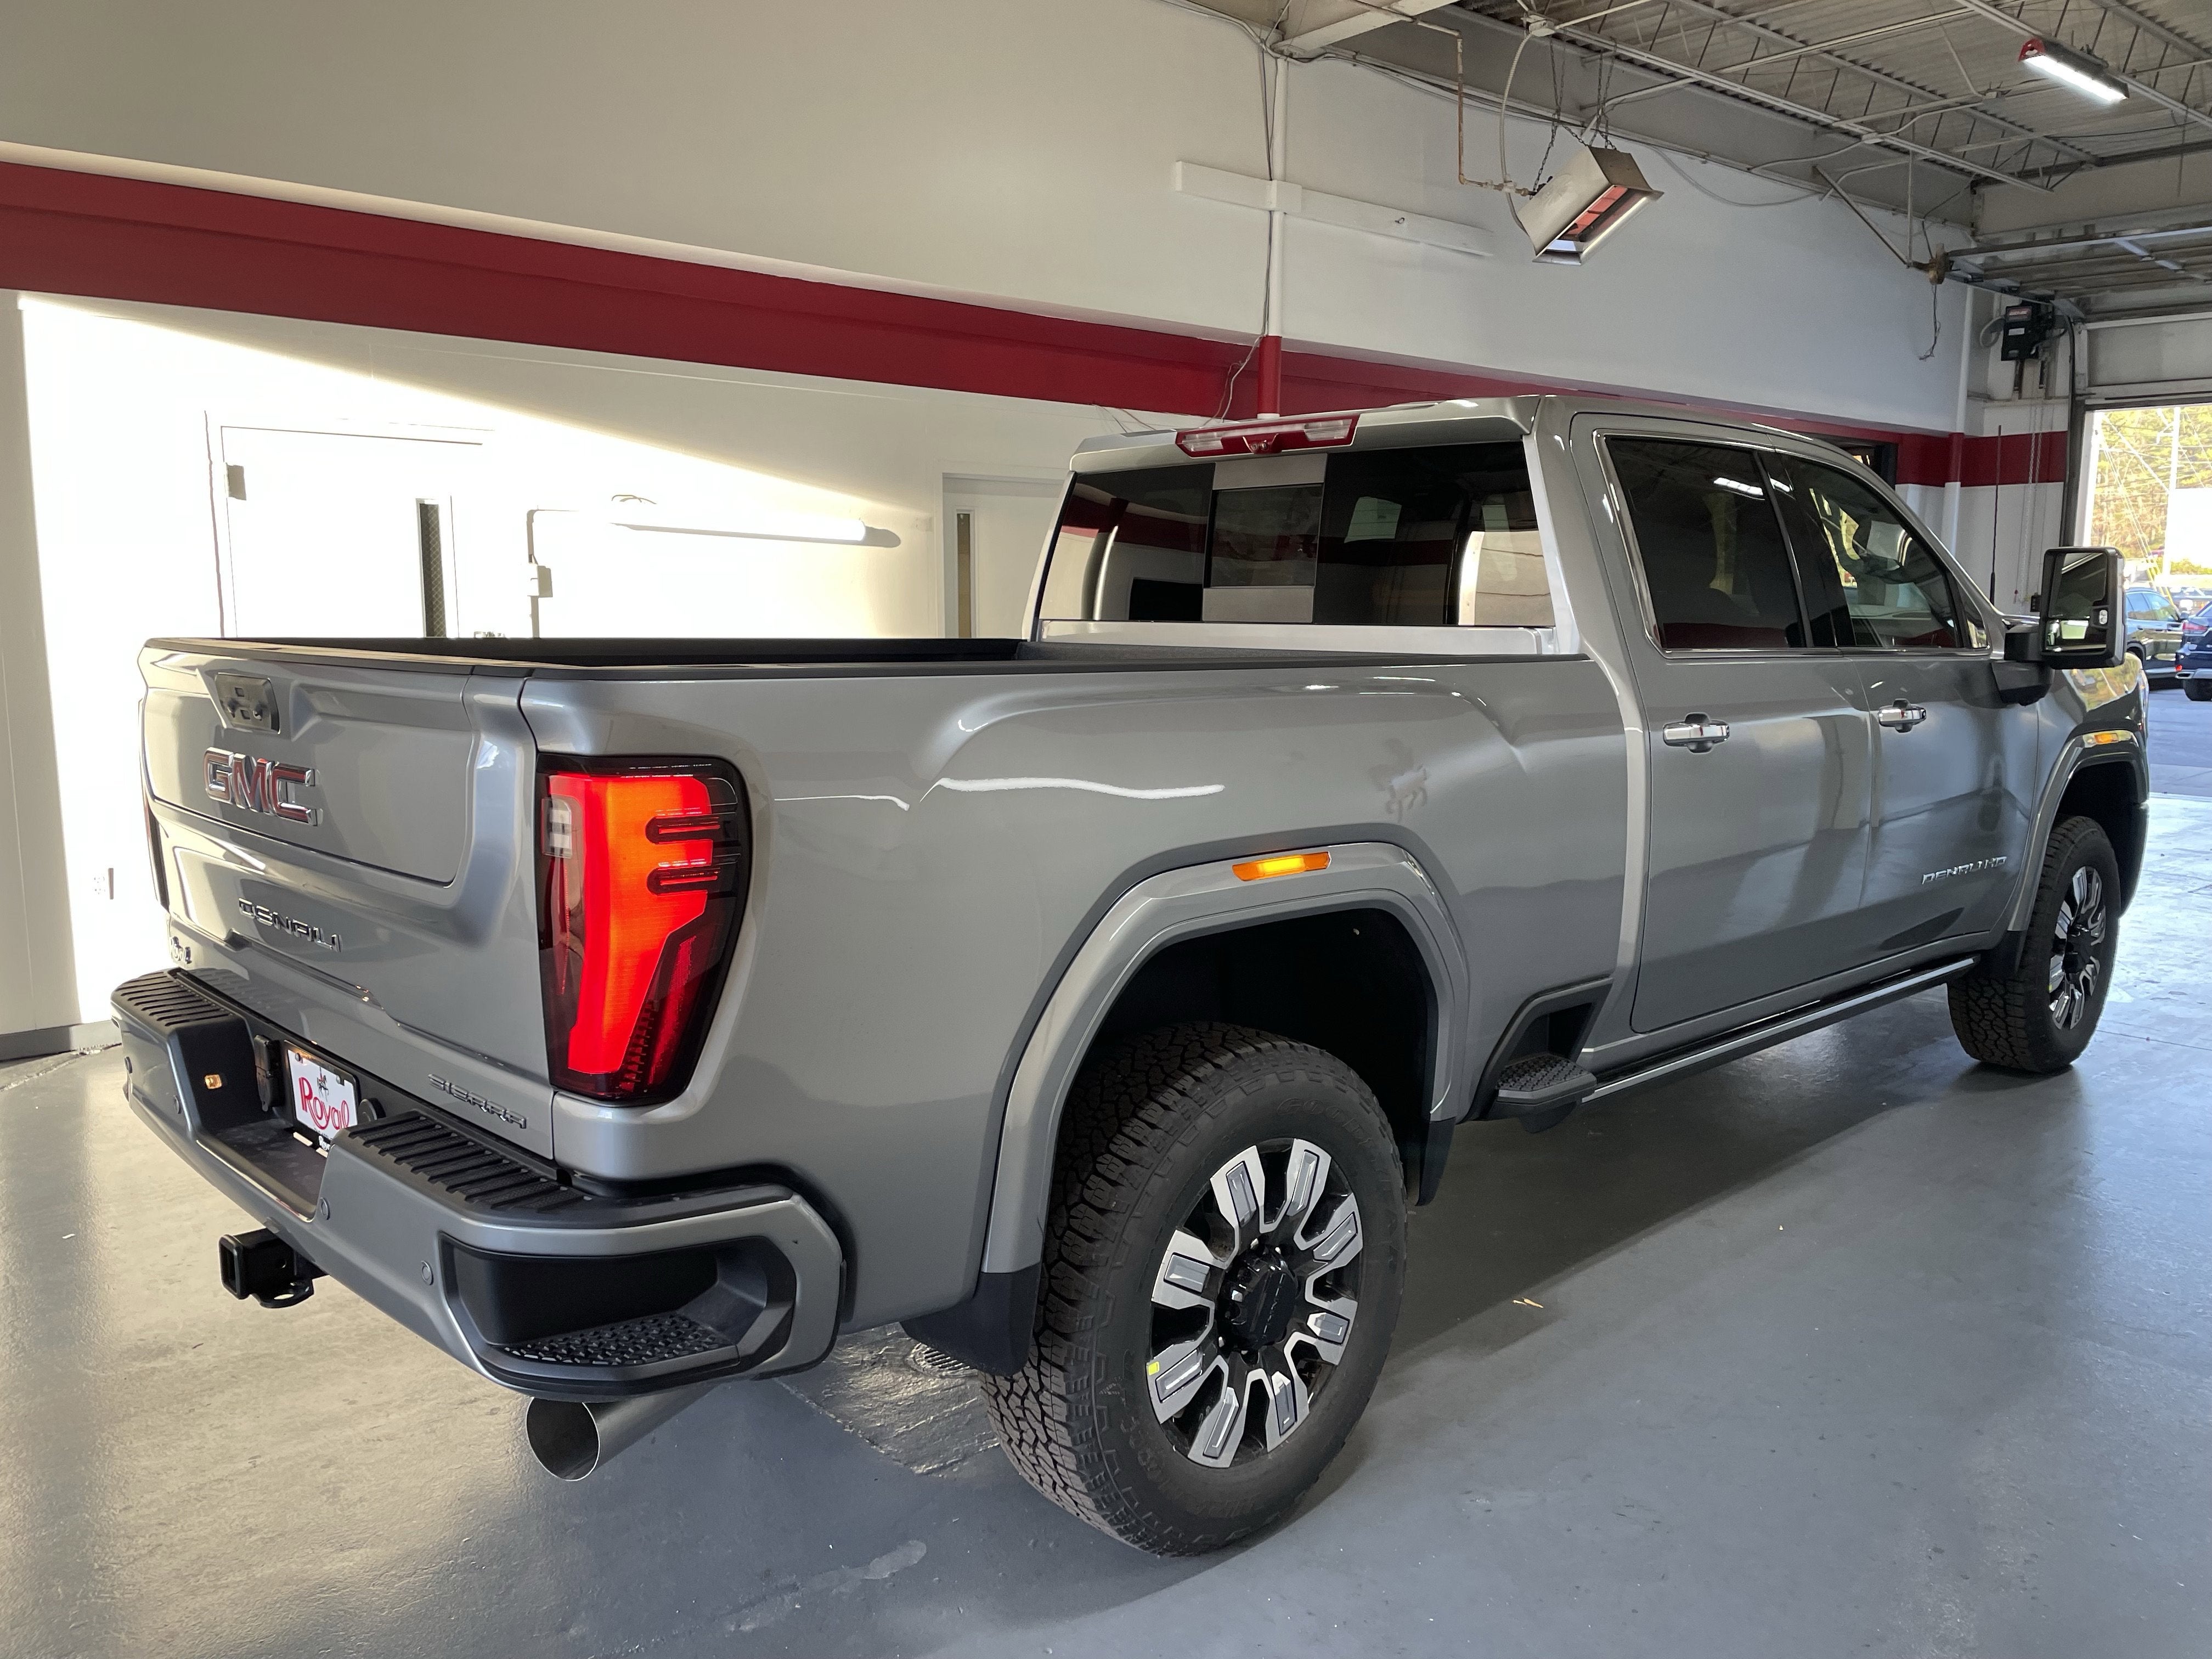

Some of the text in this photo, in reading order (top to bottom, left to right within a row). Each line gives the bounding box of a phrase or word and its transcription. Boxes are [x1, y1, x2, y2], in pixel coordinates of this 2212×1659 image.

[204, 747, 318, 826] GMC
[1922, 861, 1983, 885] DENALI
[239, 898, 343, 952] DENALI
[298, 1076, 349, 1130] Royal
[427, 1074, 527, 1129] SIERRA
